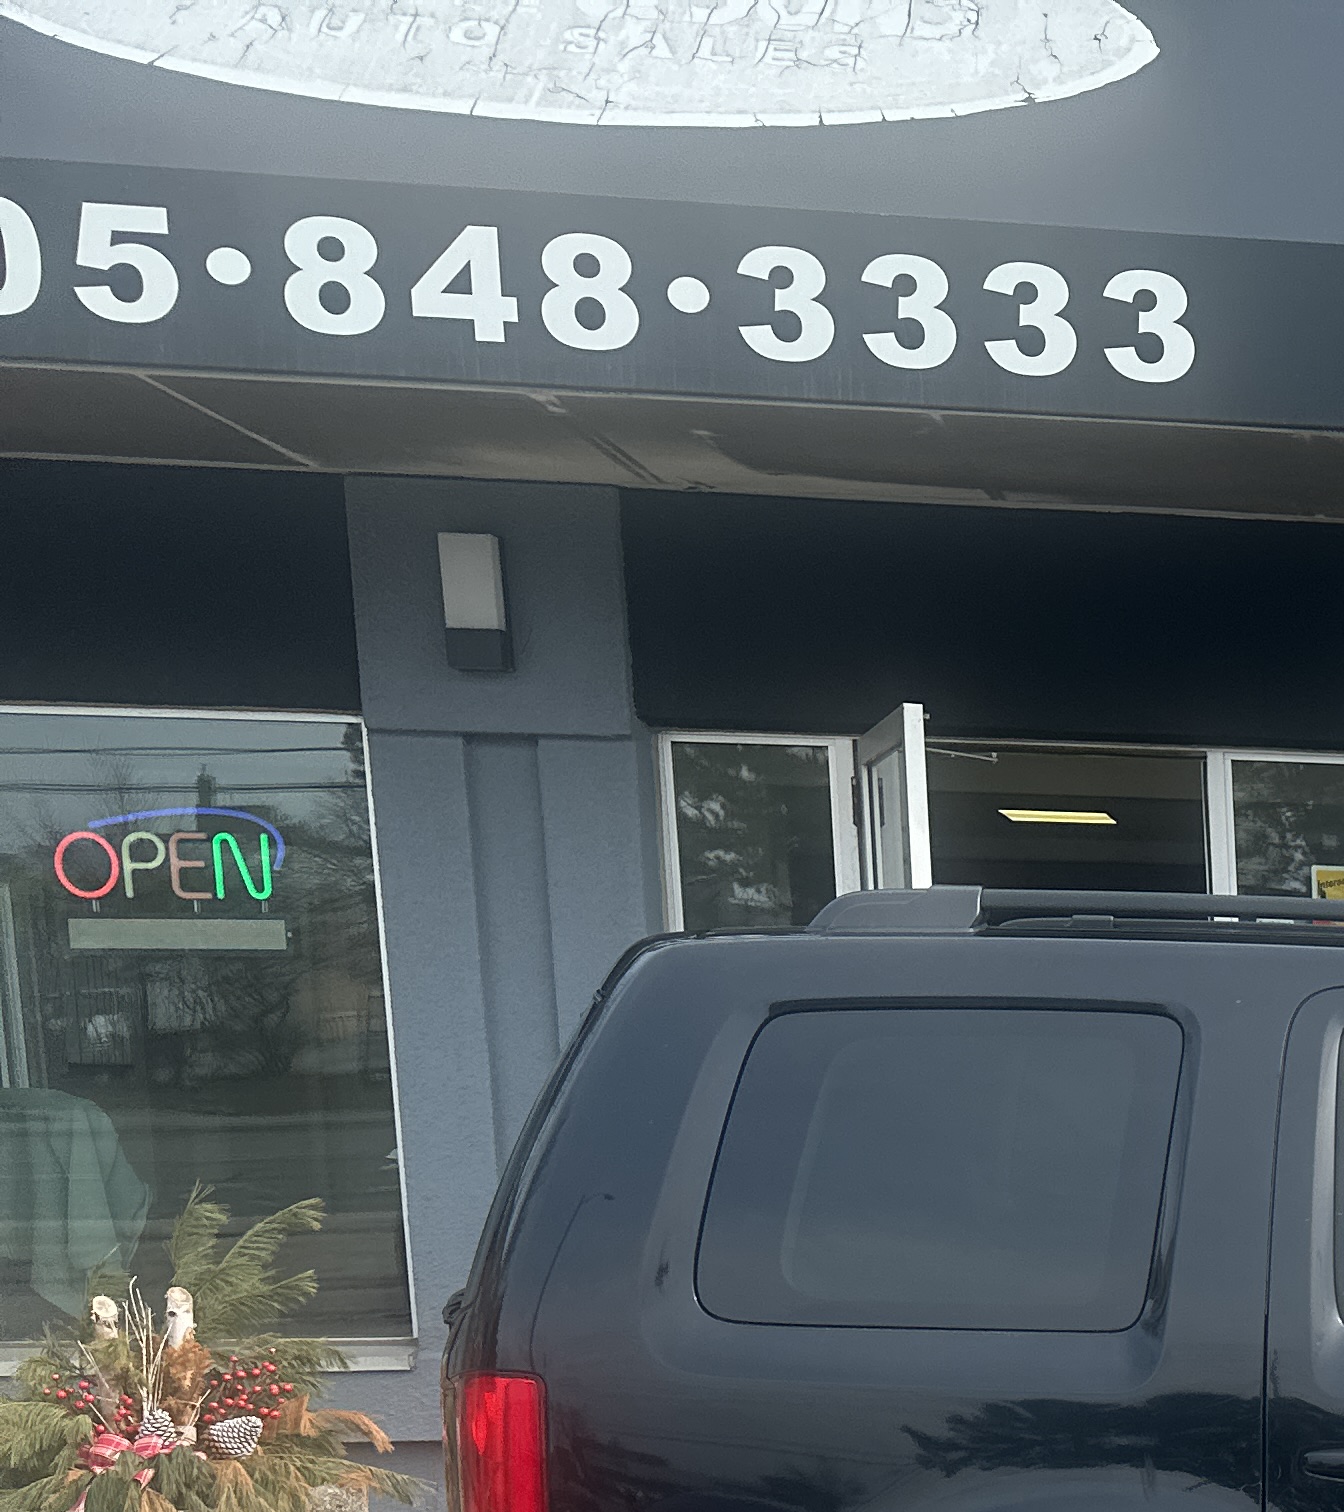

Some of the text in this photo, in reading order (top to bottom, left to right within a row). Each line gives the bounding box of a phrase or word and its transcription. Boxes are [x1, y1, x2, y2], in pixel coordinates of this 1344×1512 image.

[228, 3, 863, 69] AUTO SALES
[53, 831, 274, 900] OPEN
